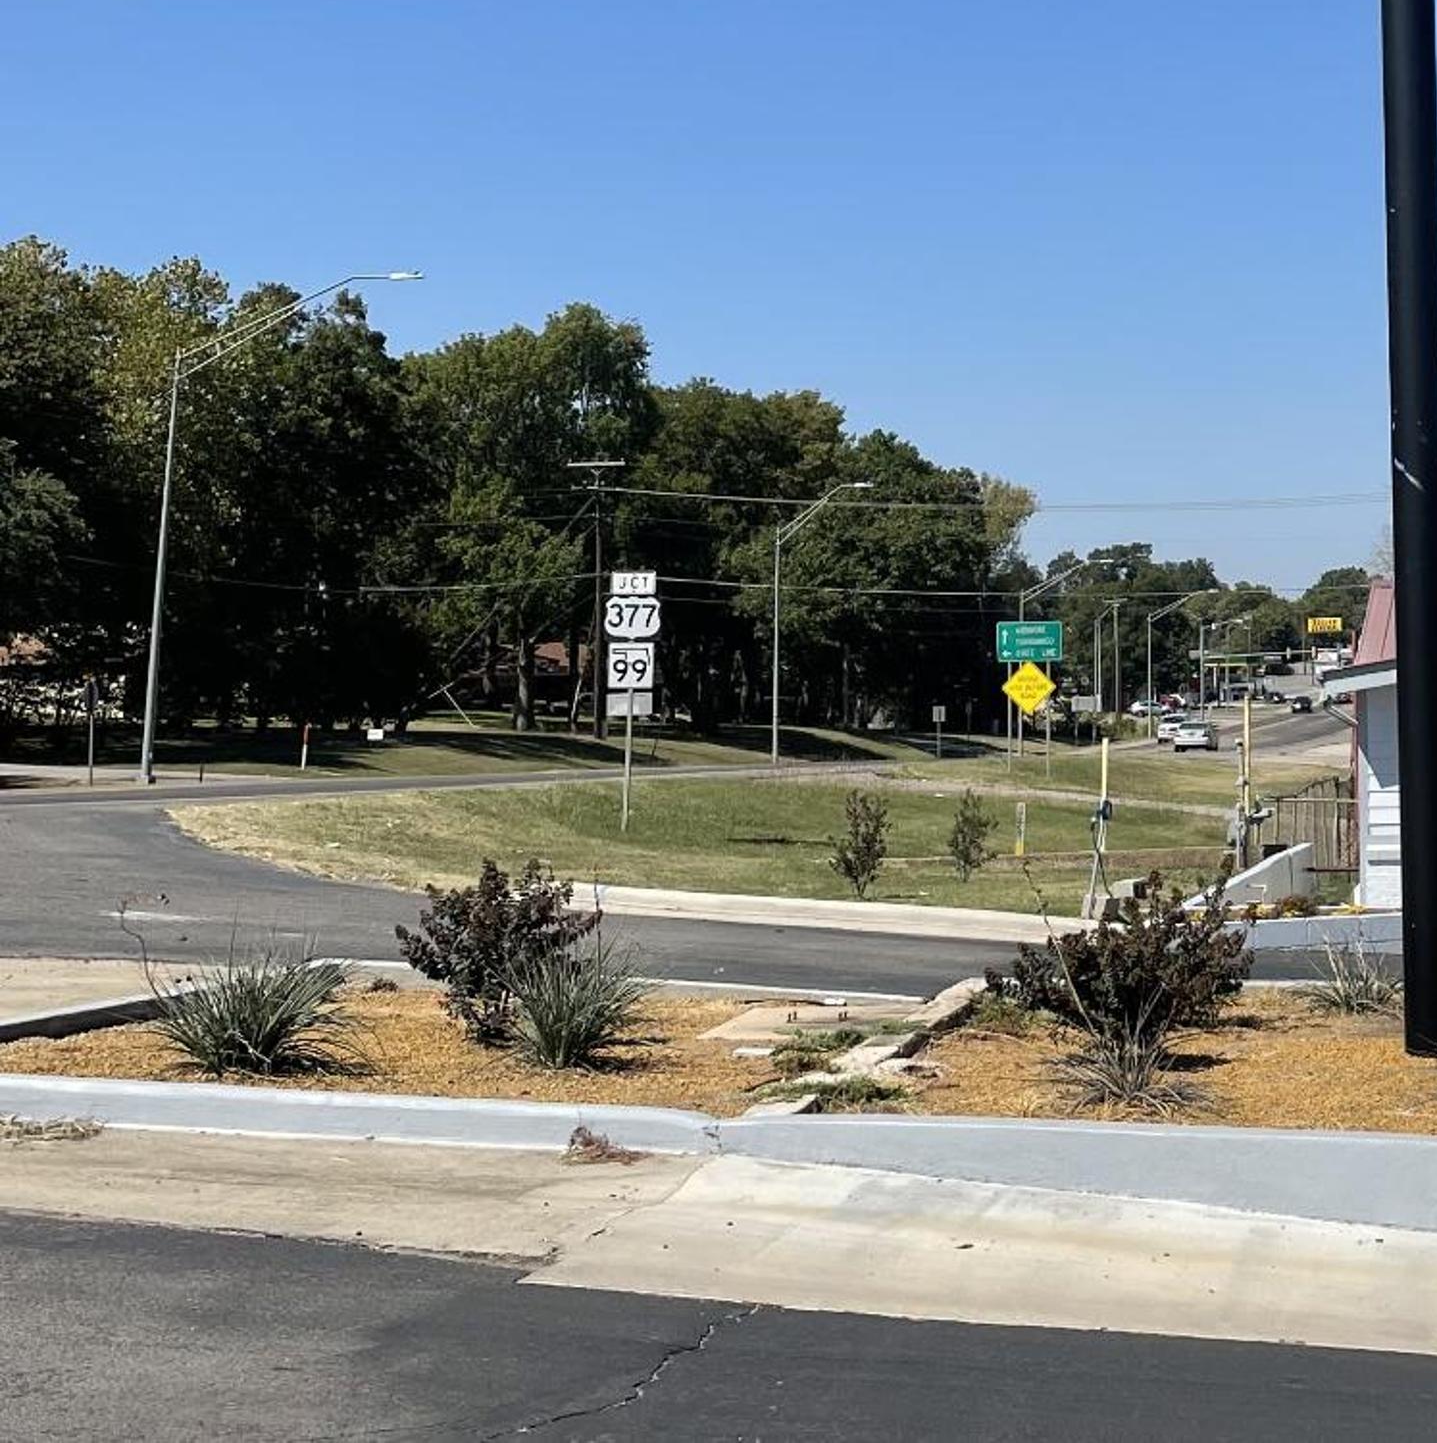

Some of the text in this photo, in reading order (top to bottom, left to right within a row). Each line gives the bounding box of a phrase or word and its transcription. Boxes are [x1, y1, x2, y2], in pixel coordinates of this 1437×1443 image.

[619, 577, 649, 589] JCT
[608, 604, 657, 628] 377
[613, 659, 647, 682] 99
